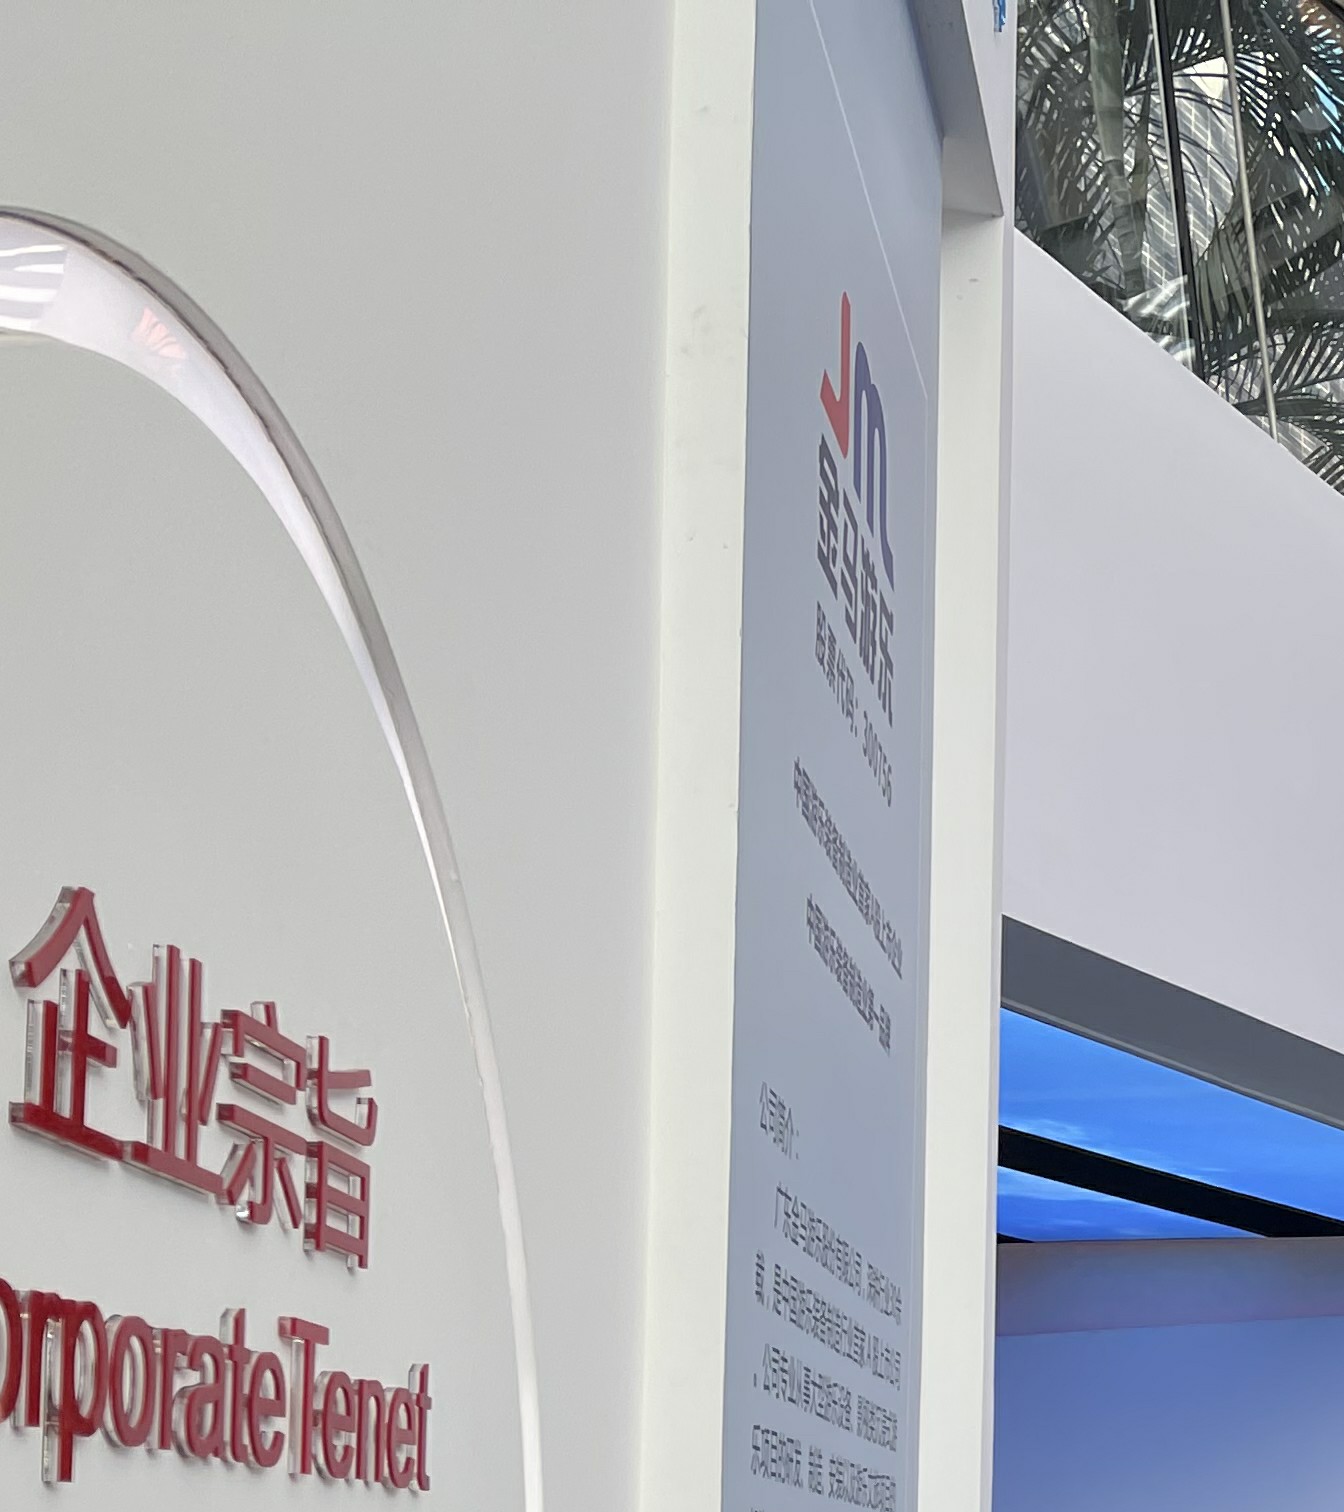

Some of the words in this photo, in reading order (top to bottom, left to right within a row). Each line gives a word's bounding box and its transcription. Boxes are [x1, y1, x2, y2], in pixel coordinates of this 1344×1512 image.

[817, 433, 893, 727] 金马游乐
[10, 887, 377, 1268] 企业宗旨
[279, 1316, 431, 1490] Tenet
